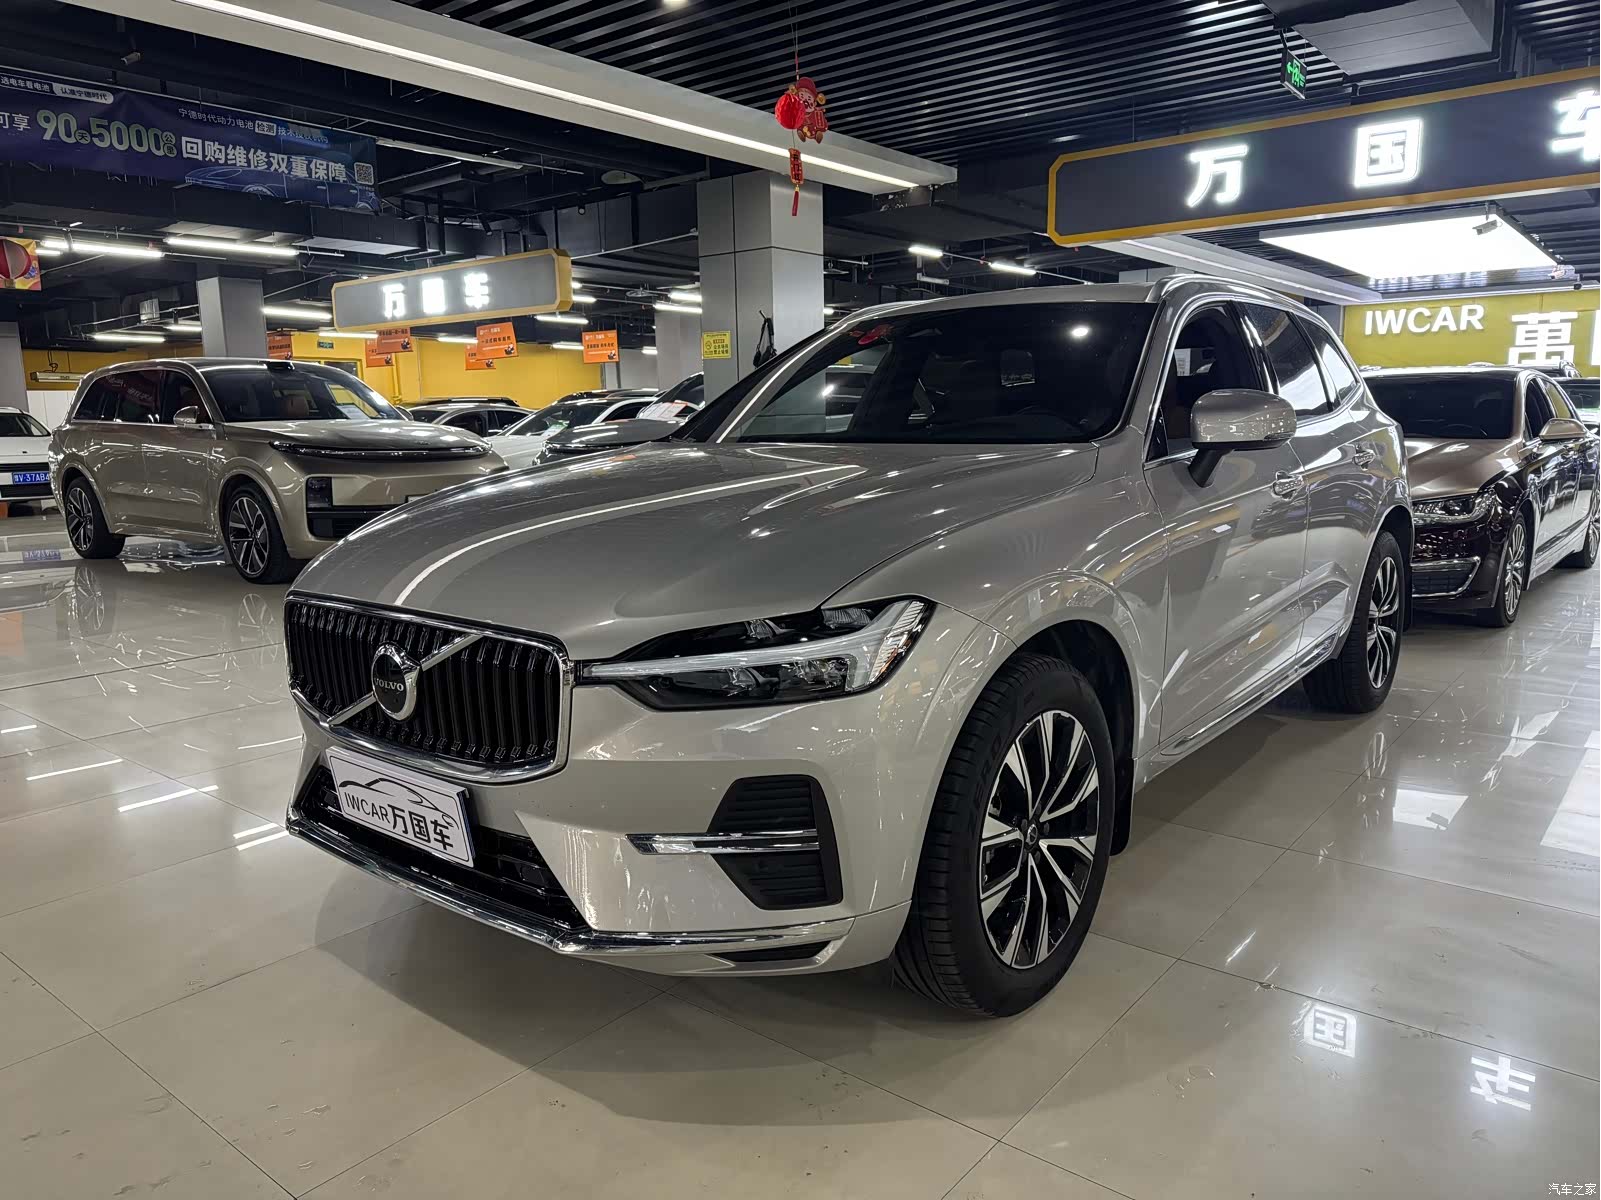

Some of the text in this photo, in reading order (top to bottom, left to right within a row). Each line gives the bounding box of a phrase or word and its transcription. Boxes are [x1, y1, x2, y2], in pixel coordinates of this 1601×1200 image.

[181, 136, 347, 183] 回购维修双重保障
[1364, 304, 1485, 336] IWCAR
[373, 677, 404, 692] VOLVO
